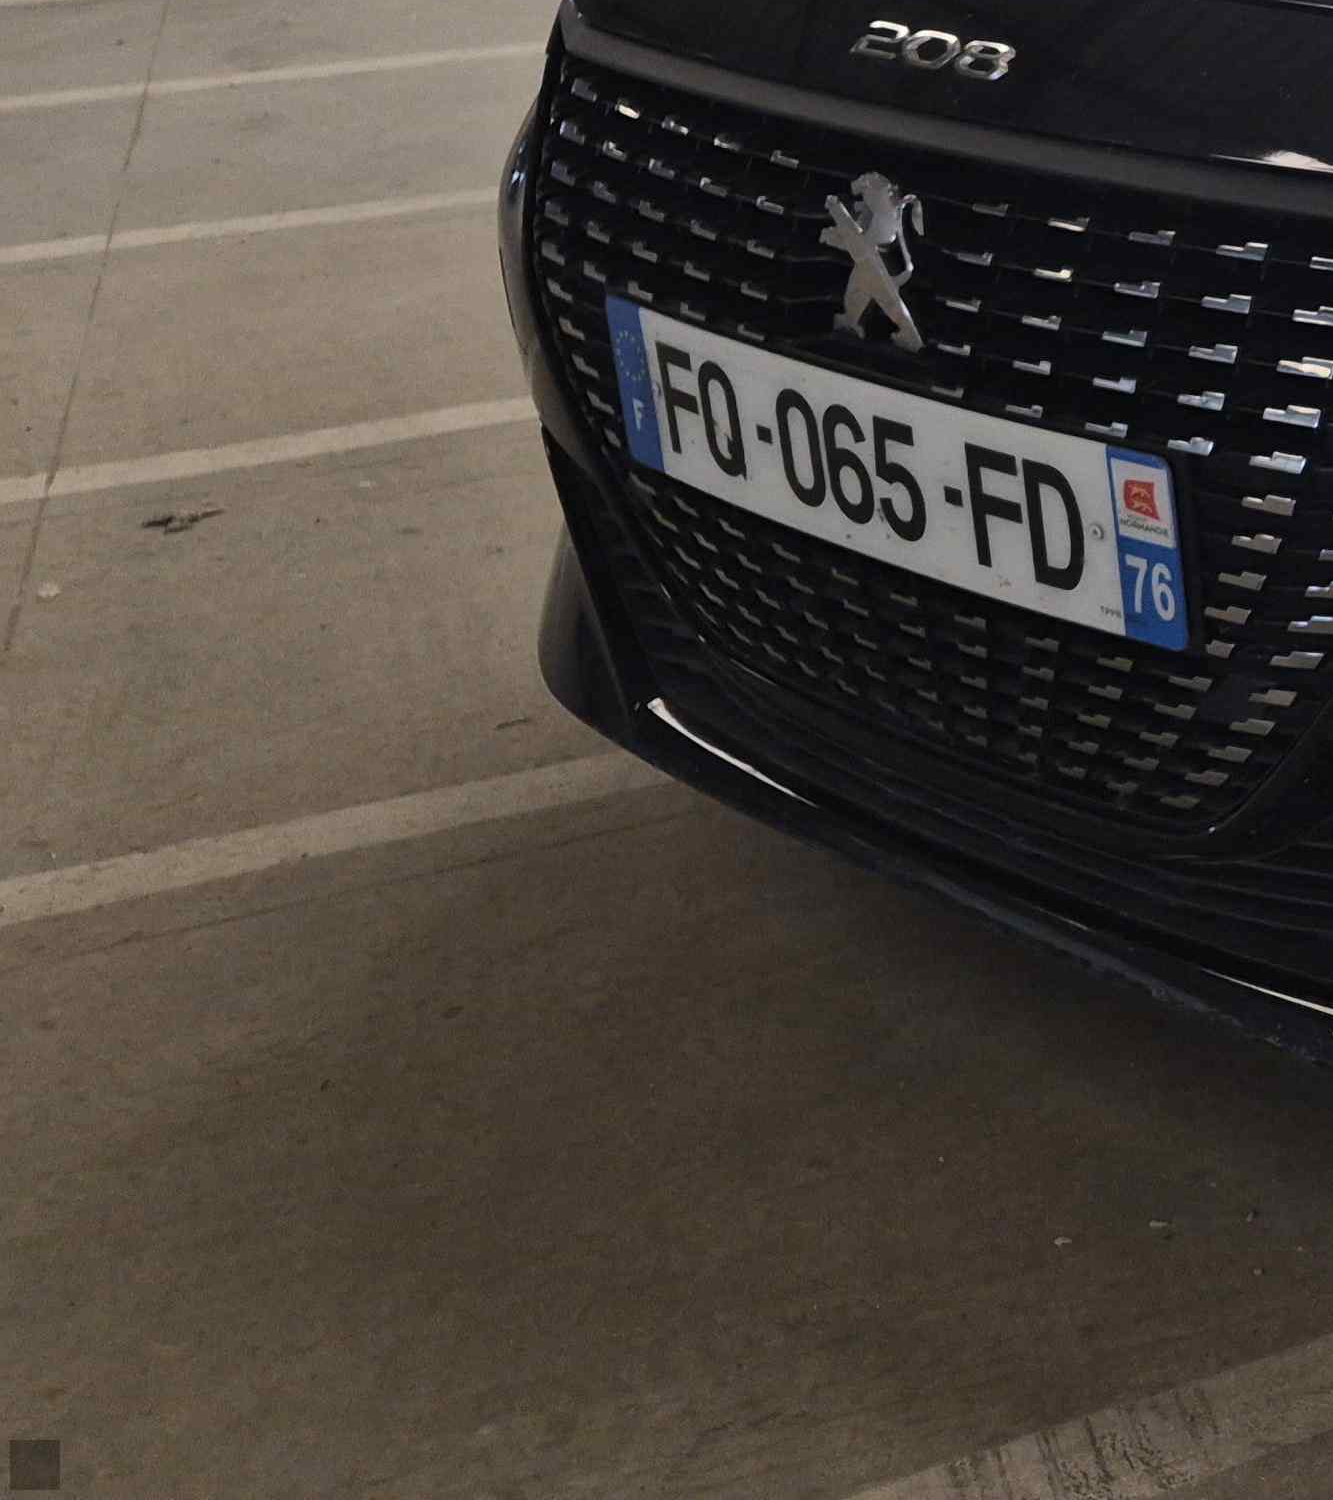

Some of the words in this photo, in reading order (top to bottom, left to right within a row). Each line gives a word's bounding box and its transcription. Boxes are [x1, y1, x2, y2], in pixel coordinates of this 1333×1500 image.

[850, 19, 1016, 81] 208
[655, 340, 1086, 592] FQ-065-FD
[1125, 553, 1176, 622] 76
